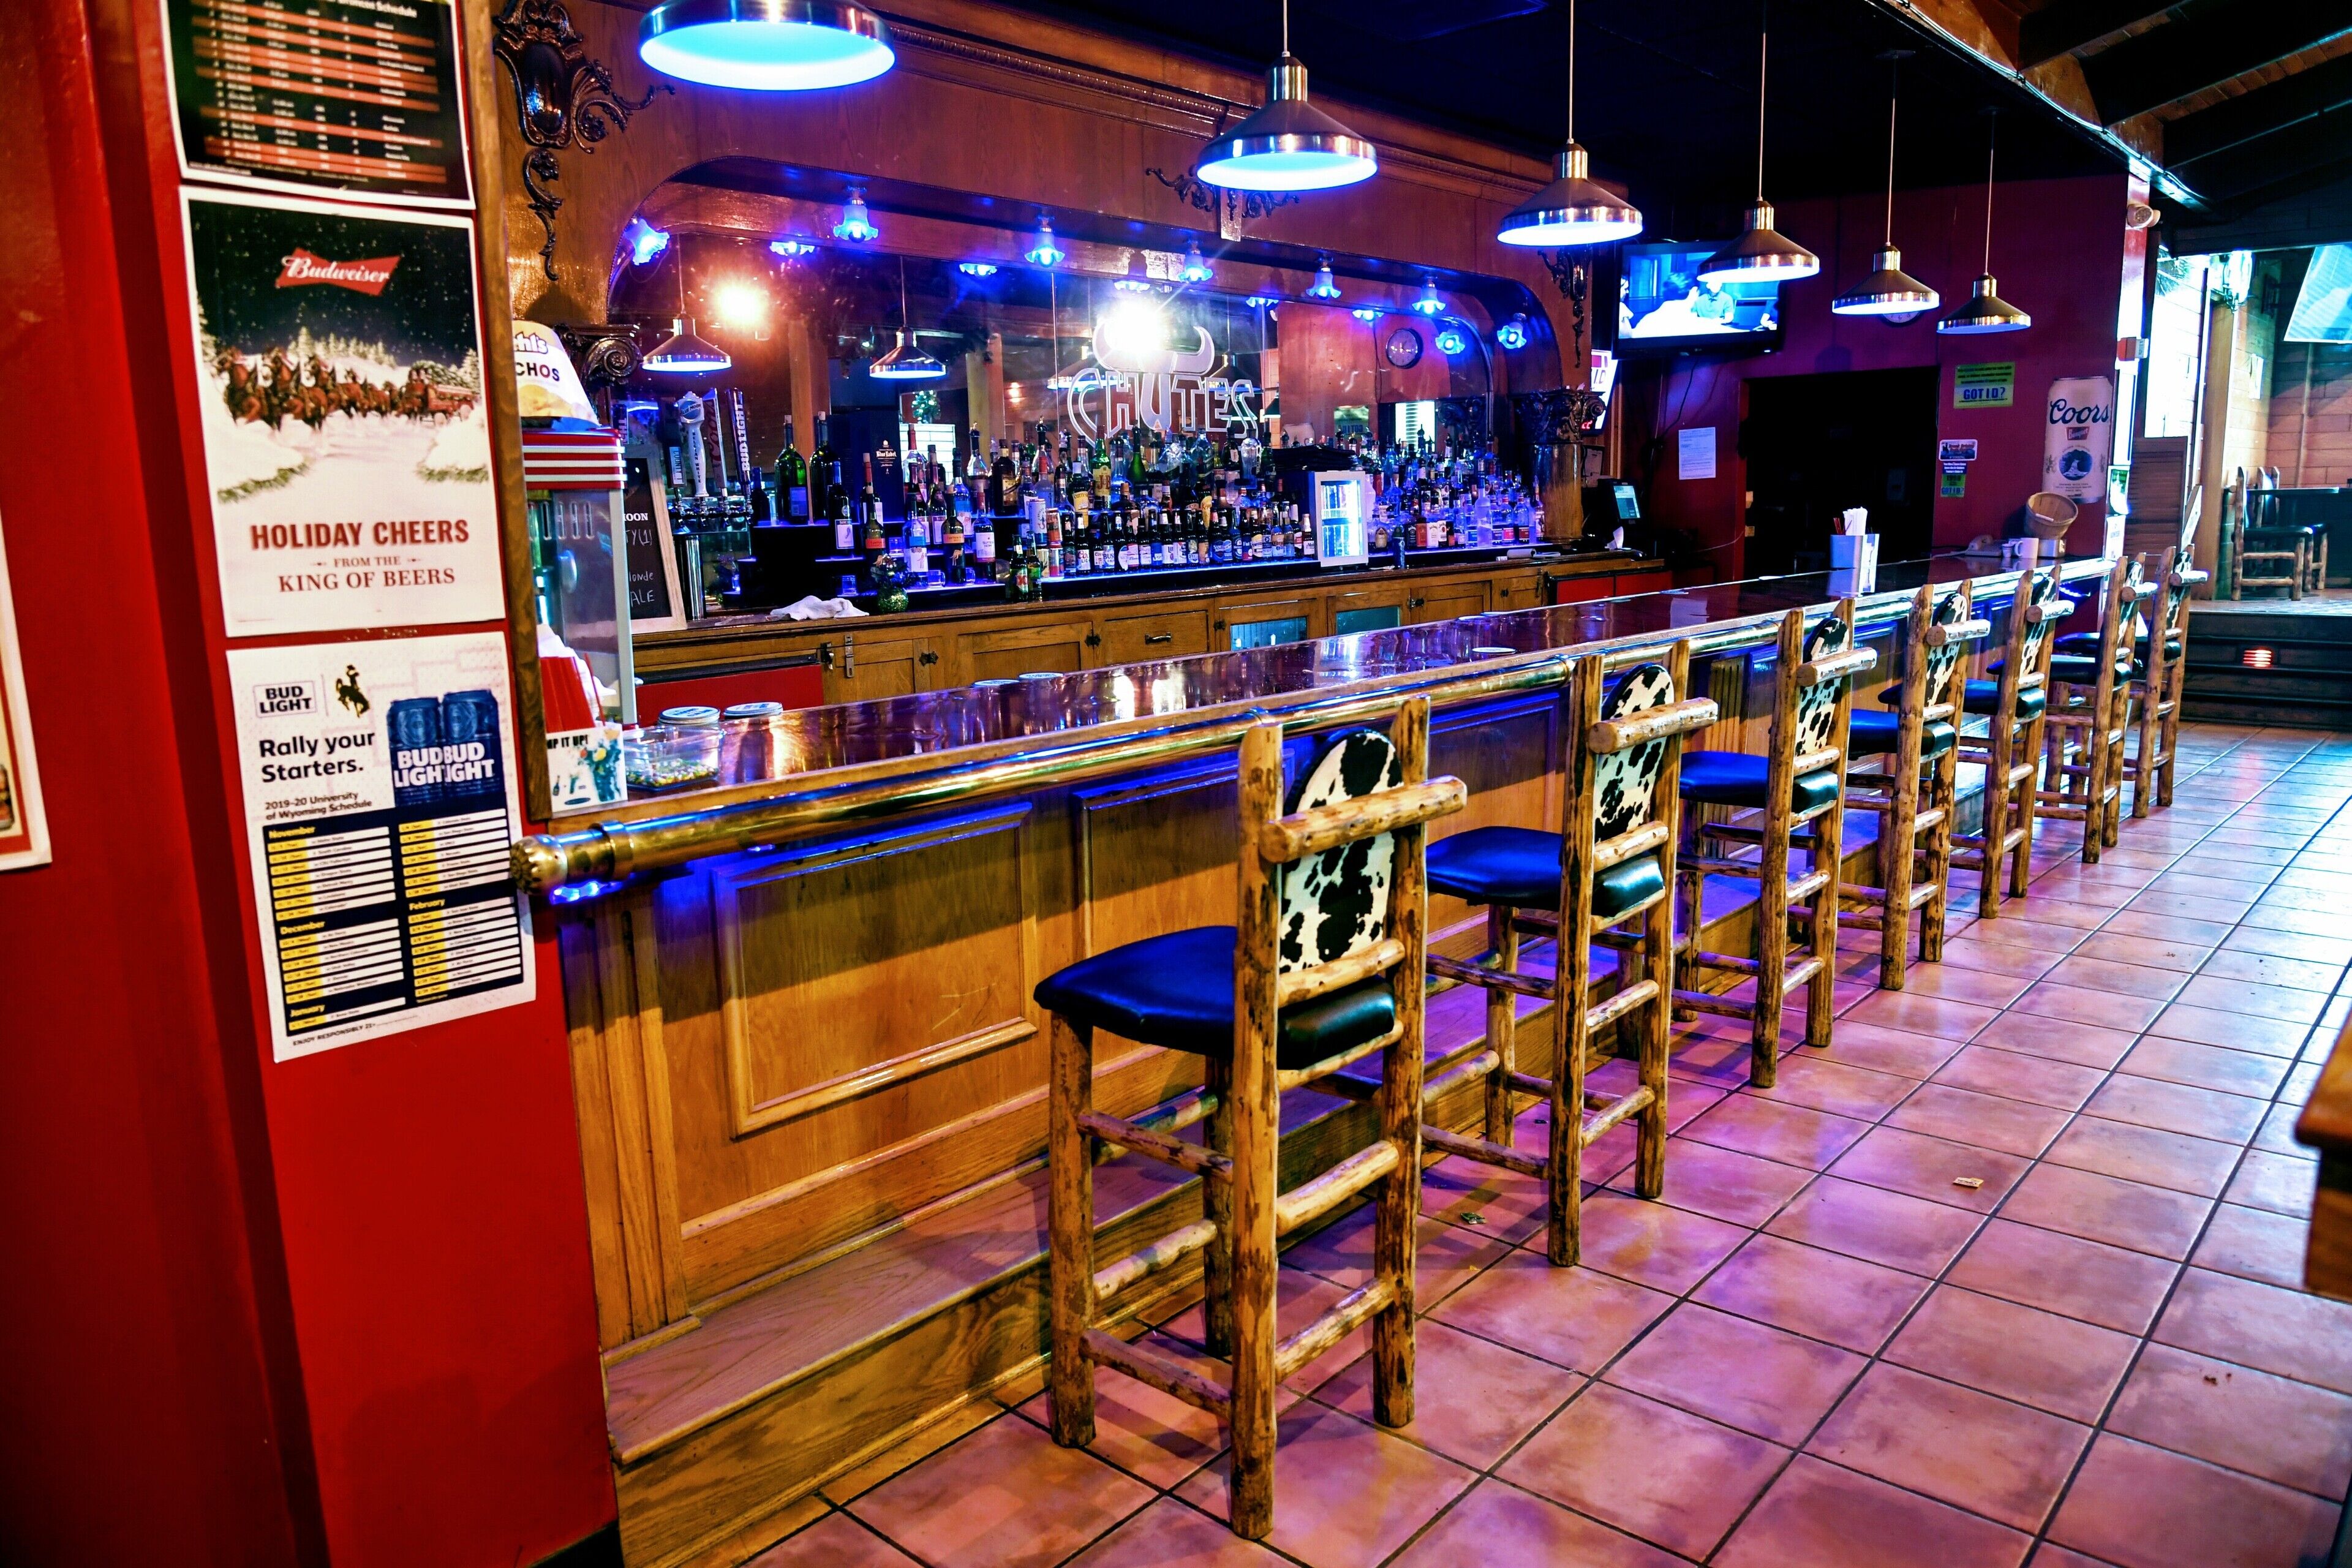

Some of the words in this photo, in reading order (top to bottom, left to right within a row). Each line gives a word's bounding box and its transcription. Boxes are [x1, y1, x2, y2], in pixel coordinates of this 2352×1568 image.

[282, 255, 390, 283] Budweiser
[516, 362, 560, 382] CHOS
[1963, 388, 1984, 400] GOT
[1067, 368, 1259, 448] CHUTES
[2049, 398, 2109, 424] Coors
[734, 403, 748, 442] LIGHT
[739, 442, 751, 472] BUD
[624, 513, 649, 521] OON
[250, 522, 363, 549] HOLIDAY
[372, 519, 469, 545] CHEERS
[333, 556, 371, 568] FROM
[375, 555, 401, 566] THE
[277, 571, 339, 593] KING
[347, 570, 375, 589] OF
[382, 568, 456, 587] BEERS
[265, 685, 304, 700] BUD
[259, 697, 312, 714] LIGHT
[259, 735, 318, 757] Rally
[325, 733, 375, 755] your
[443, 742, 486, 764] BUD
[396, 747, 444, 769] BUD
[262, 759, 363, 783] Starters.
[265, 797, 307, 810] 2019-20
[310, 791, 358, 804] University
[266, 812, 276, 821] of
[279, 807, 326, 820] Wyoming
[329, 800, 372, 812] Schedule
[409, 899, 445, 911] February
